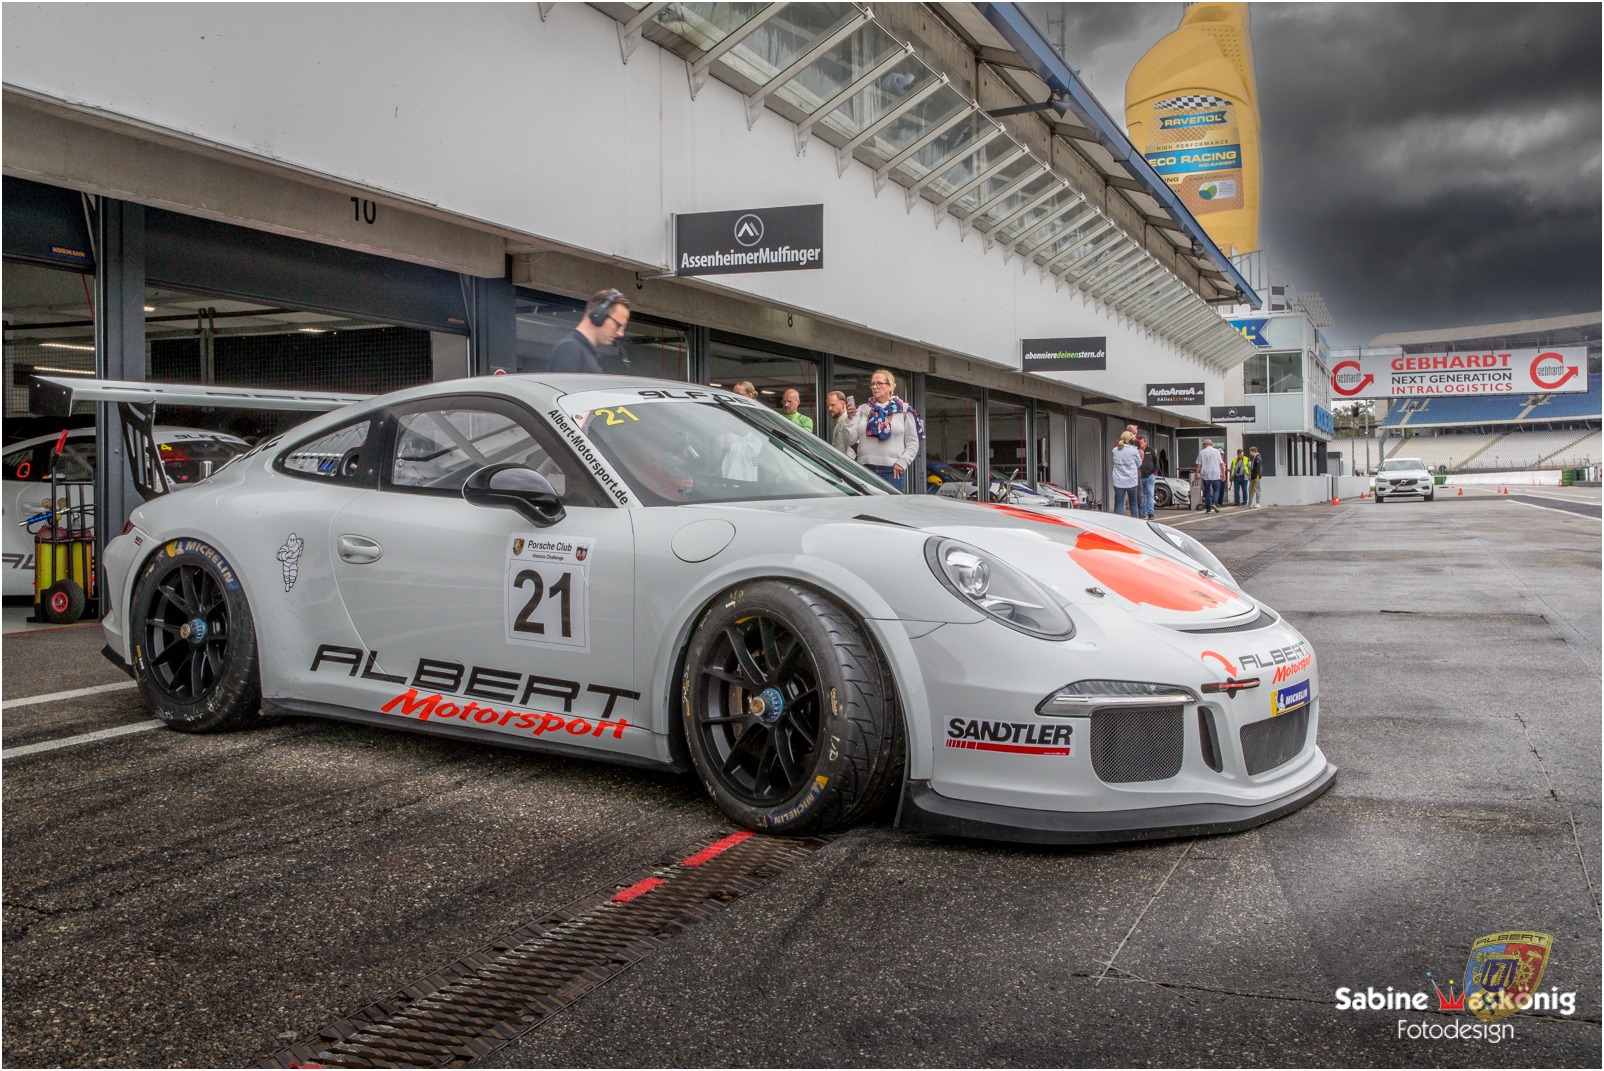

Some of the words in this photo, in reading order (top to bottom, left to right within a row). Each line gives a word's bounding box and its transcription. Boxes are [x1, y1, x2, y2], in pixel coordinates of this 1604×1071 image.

[1164, 114, 1222, 127] RAVENOL
[1176, 139, 1229, 149] PERFORMANCE
[1148, 157, 1177, 167] ECO
[1181, 151, 1237, 164] RACING
[350, 196, 377, 225] 10
[681, 245, 821, 269] AssenheimerMulfinger
[1024, 350, 1105, 360] abonnieredeinenstern.de
[1391, 354, 1512, 371] GEBHARDT
[1391, 375, 1426, 385] NEXT
[1429, 372, 1512, 383] GENERATION
[1537, 365, 1565, 377] gebhardt
[1391, 383, 1513, 395] INTRALOGISTICS
[594, 406, 640, 426] 21
[547, 408, 629, 506] Albert-Motorsport.de
[527, 539, 555, 551] Porsche
[556, 541, 572, 552] Club
[185, 540, 235, 584] MICHELIN
[513, 568, 572, 638] 21
[1238, 640, 1309, 671] ALBERT
[310, 643, 641, 719] ALBERT
[1285, 688, 1309, 706] MICHELIN
[381, 688, 633, 740] Motorsport
[947, 717, 1074, 746] SANDTLER
[773, 792, 816, 825] MICHELIN
